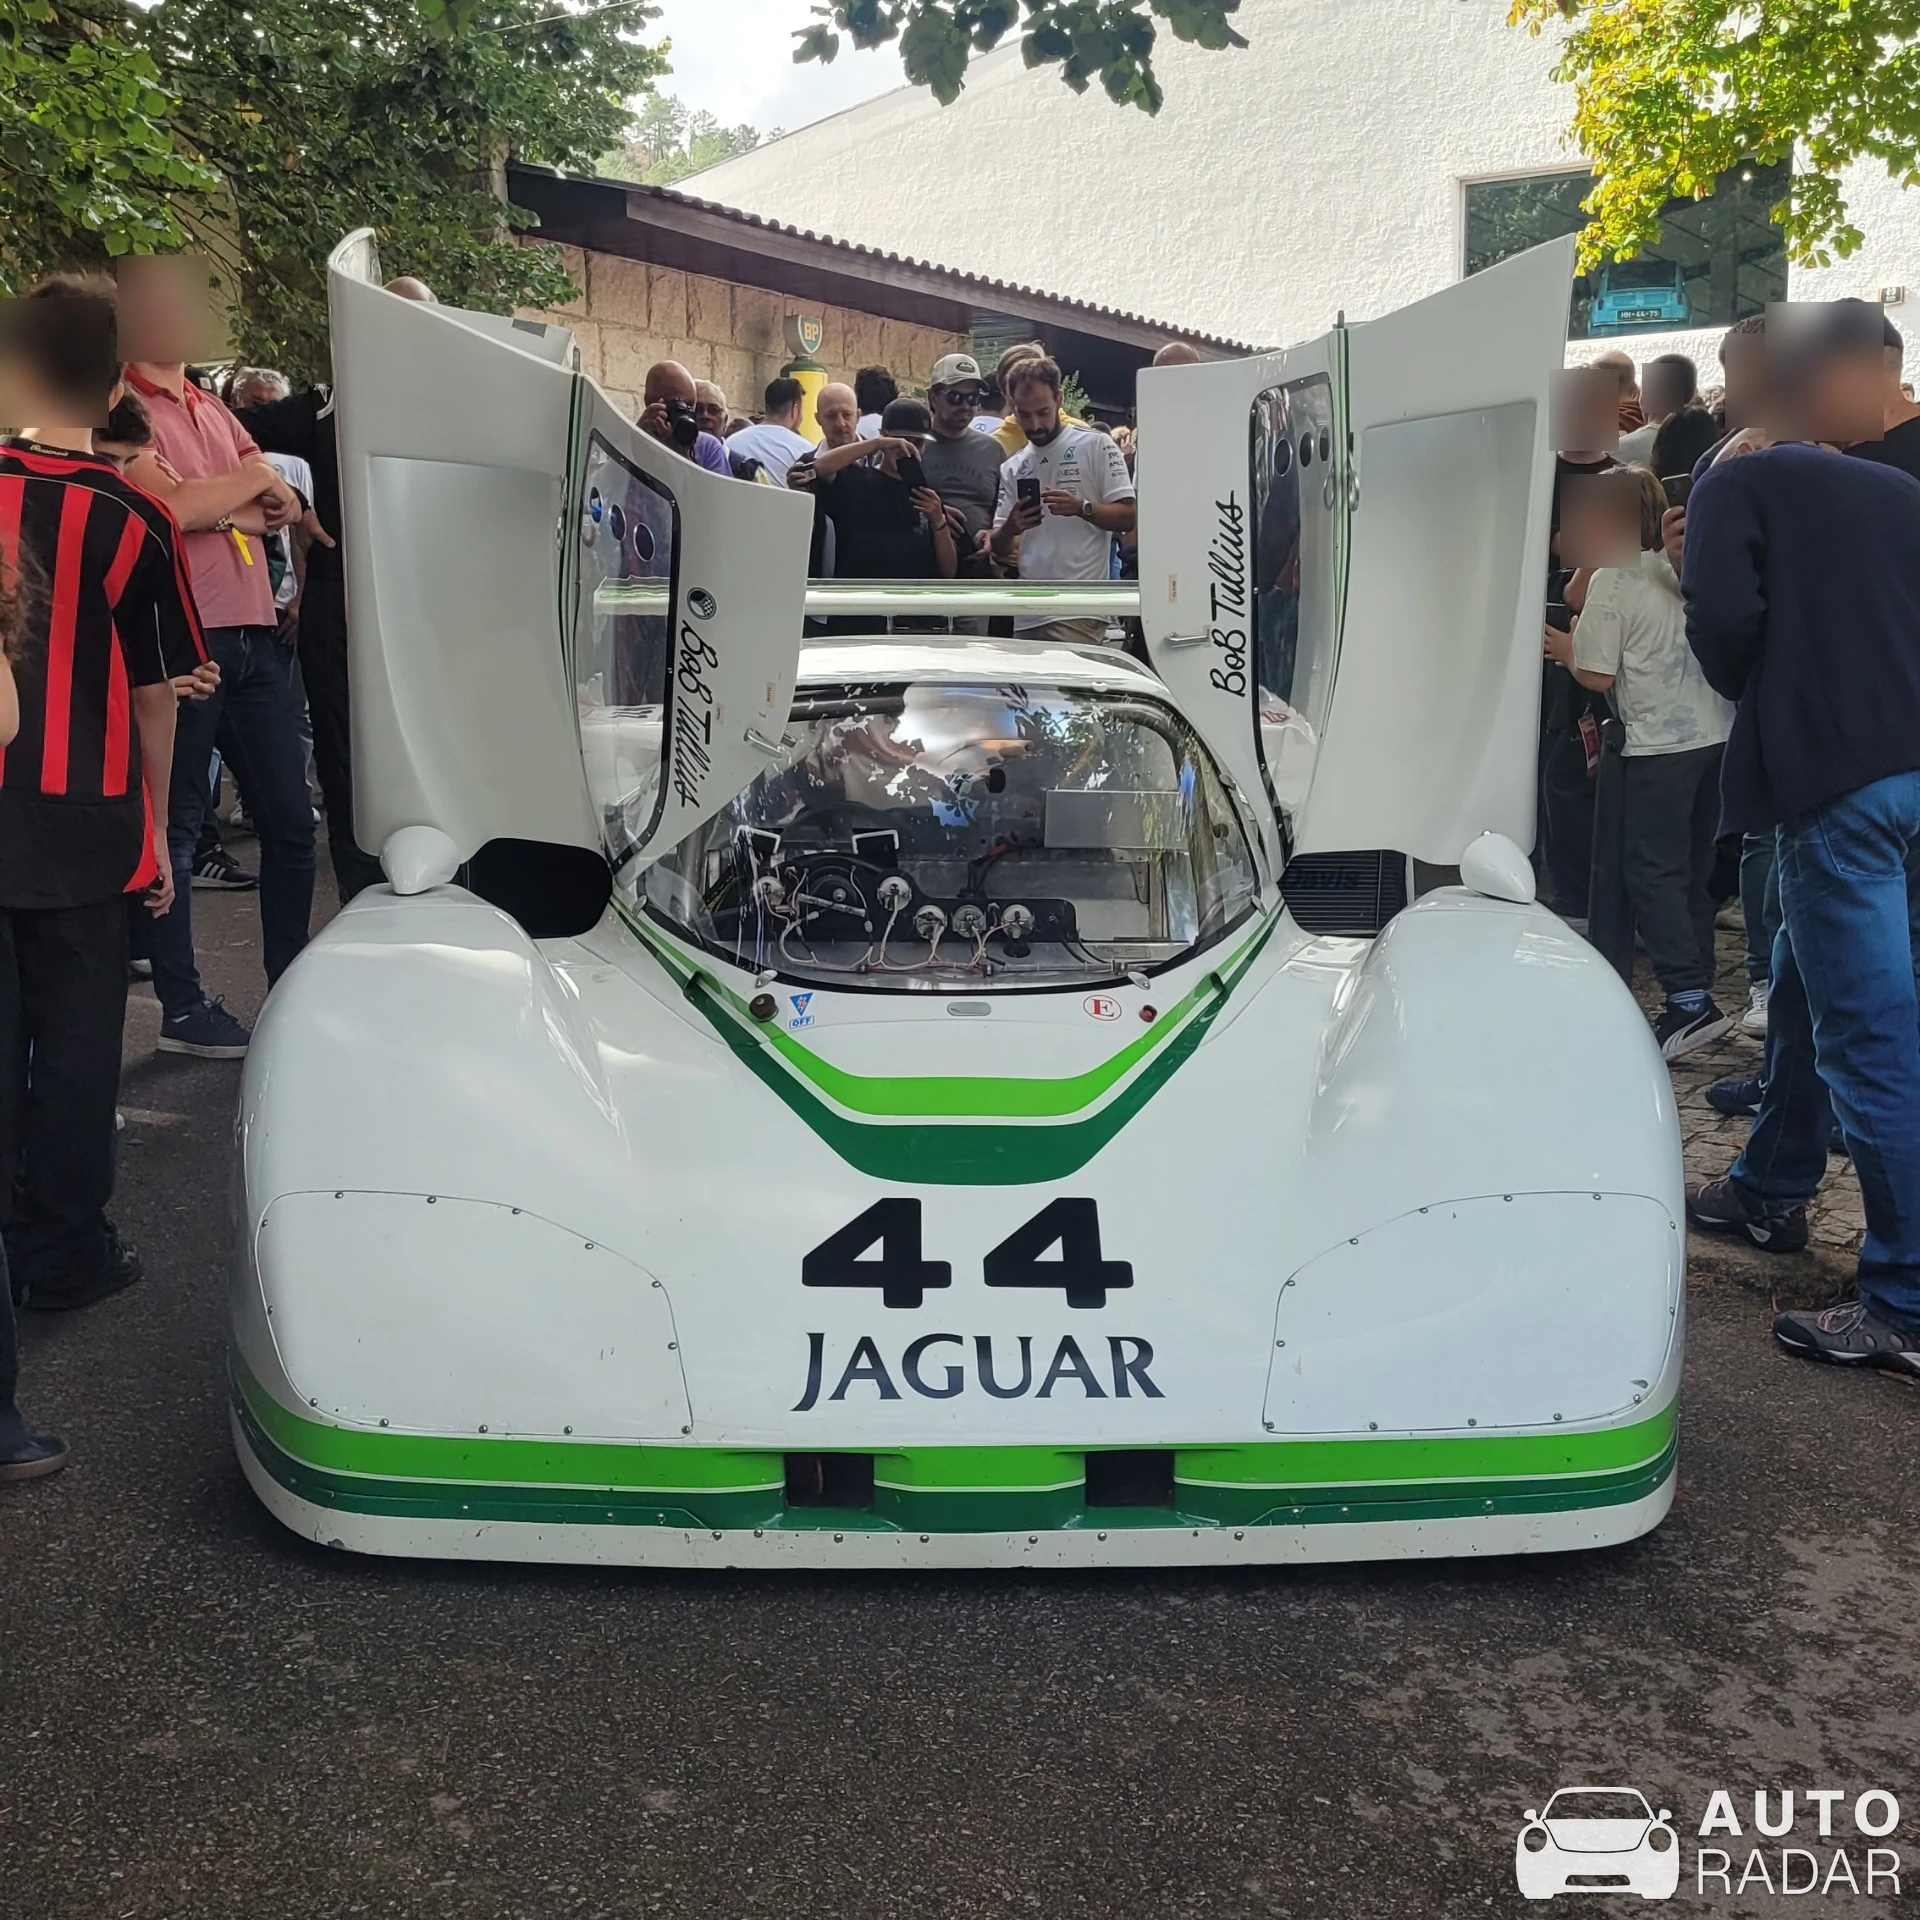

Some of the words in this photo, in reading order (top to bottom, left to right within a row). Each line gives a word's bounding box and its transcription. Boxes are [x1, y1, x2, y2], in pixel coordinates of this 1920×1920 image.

[803, 321, 819, 342] BP
[1208, 490, 1246, 622] Tullius
[674, 695, 712, 808] Tullius
[792, 1016, 811, 1027] OFF
[1090, 998, 1115, 1018] E
[801, 1197, 1134, 1309] 44
[791, 1332, 1166, 1412] JAGUAR
